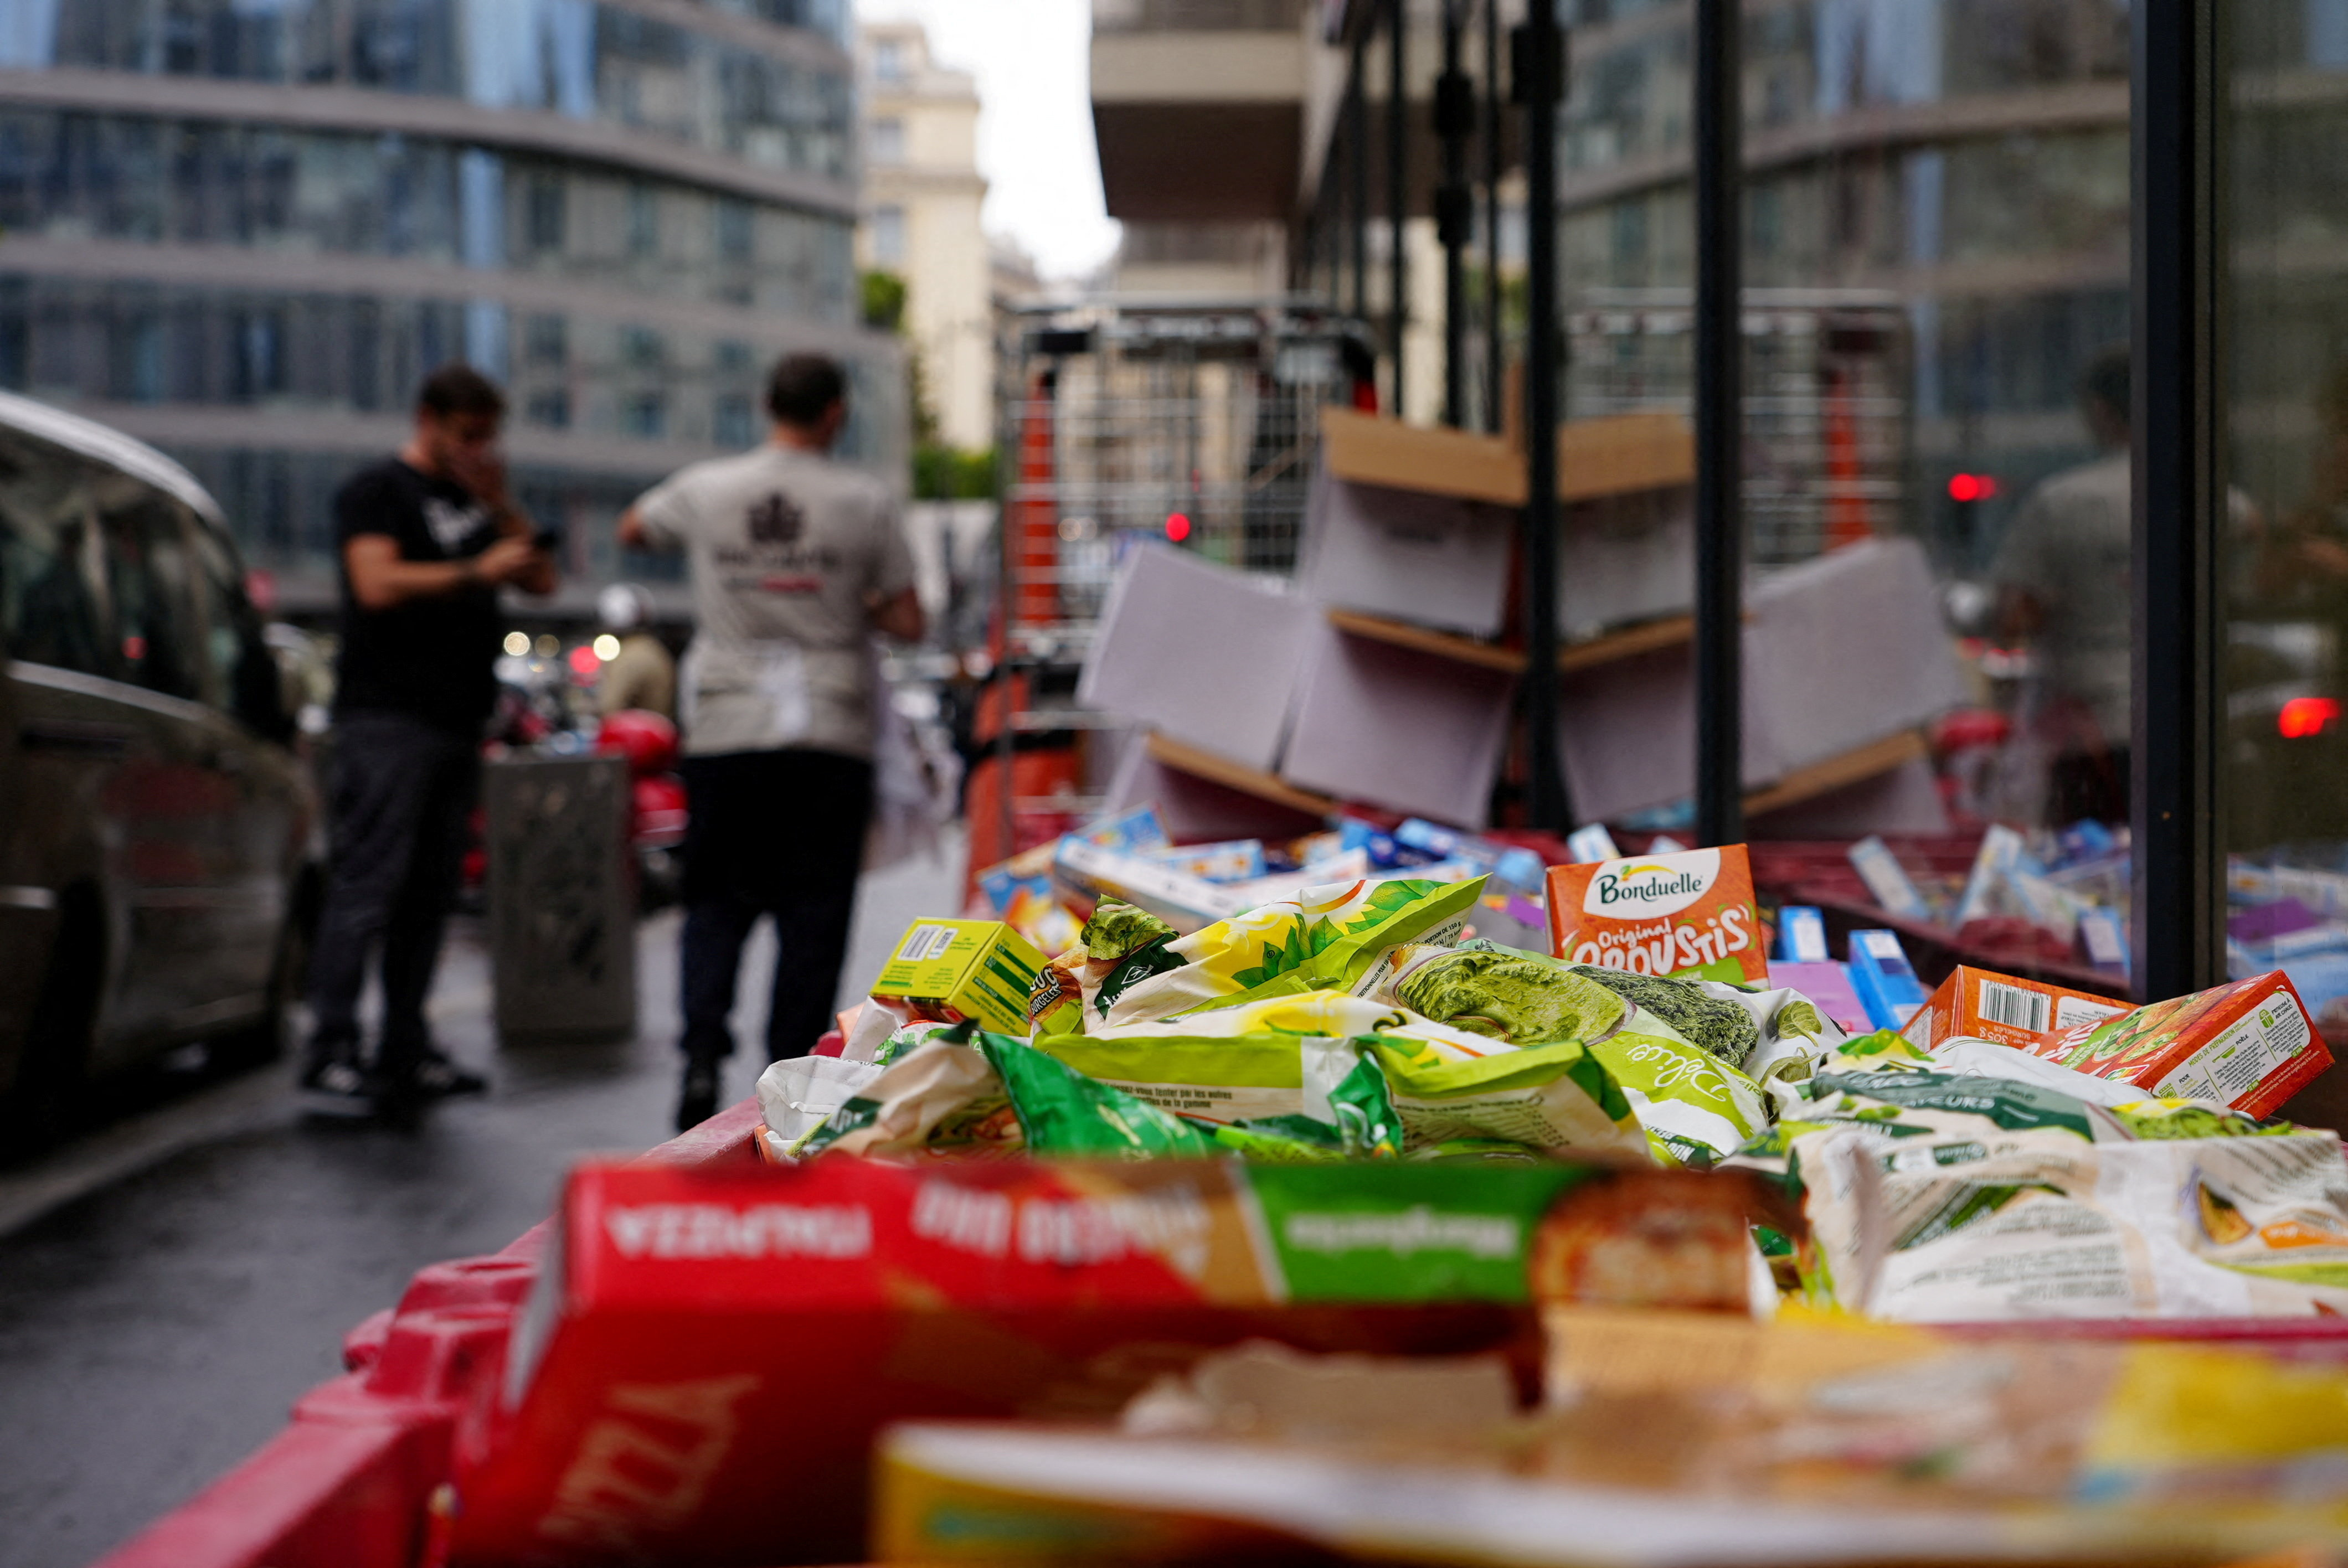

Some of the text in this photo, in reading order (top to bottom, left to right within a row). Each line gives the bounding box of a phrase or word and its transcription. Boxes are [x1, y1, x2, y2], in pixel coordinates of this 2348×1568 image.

[1596, 873, 1703, 904] Bonduelle
[1598, 917, 1672, 948] Original
[1979, 1027, 1986, 1039] g
[1987, 1033, 2008, 1045] 305
[2189, 1054, 2203, 1065] MODES
